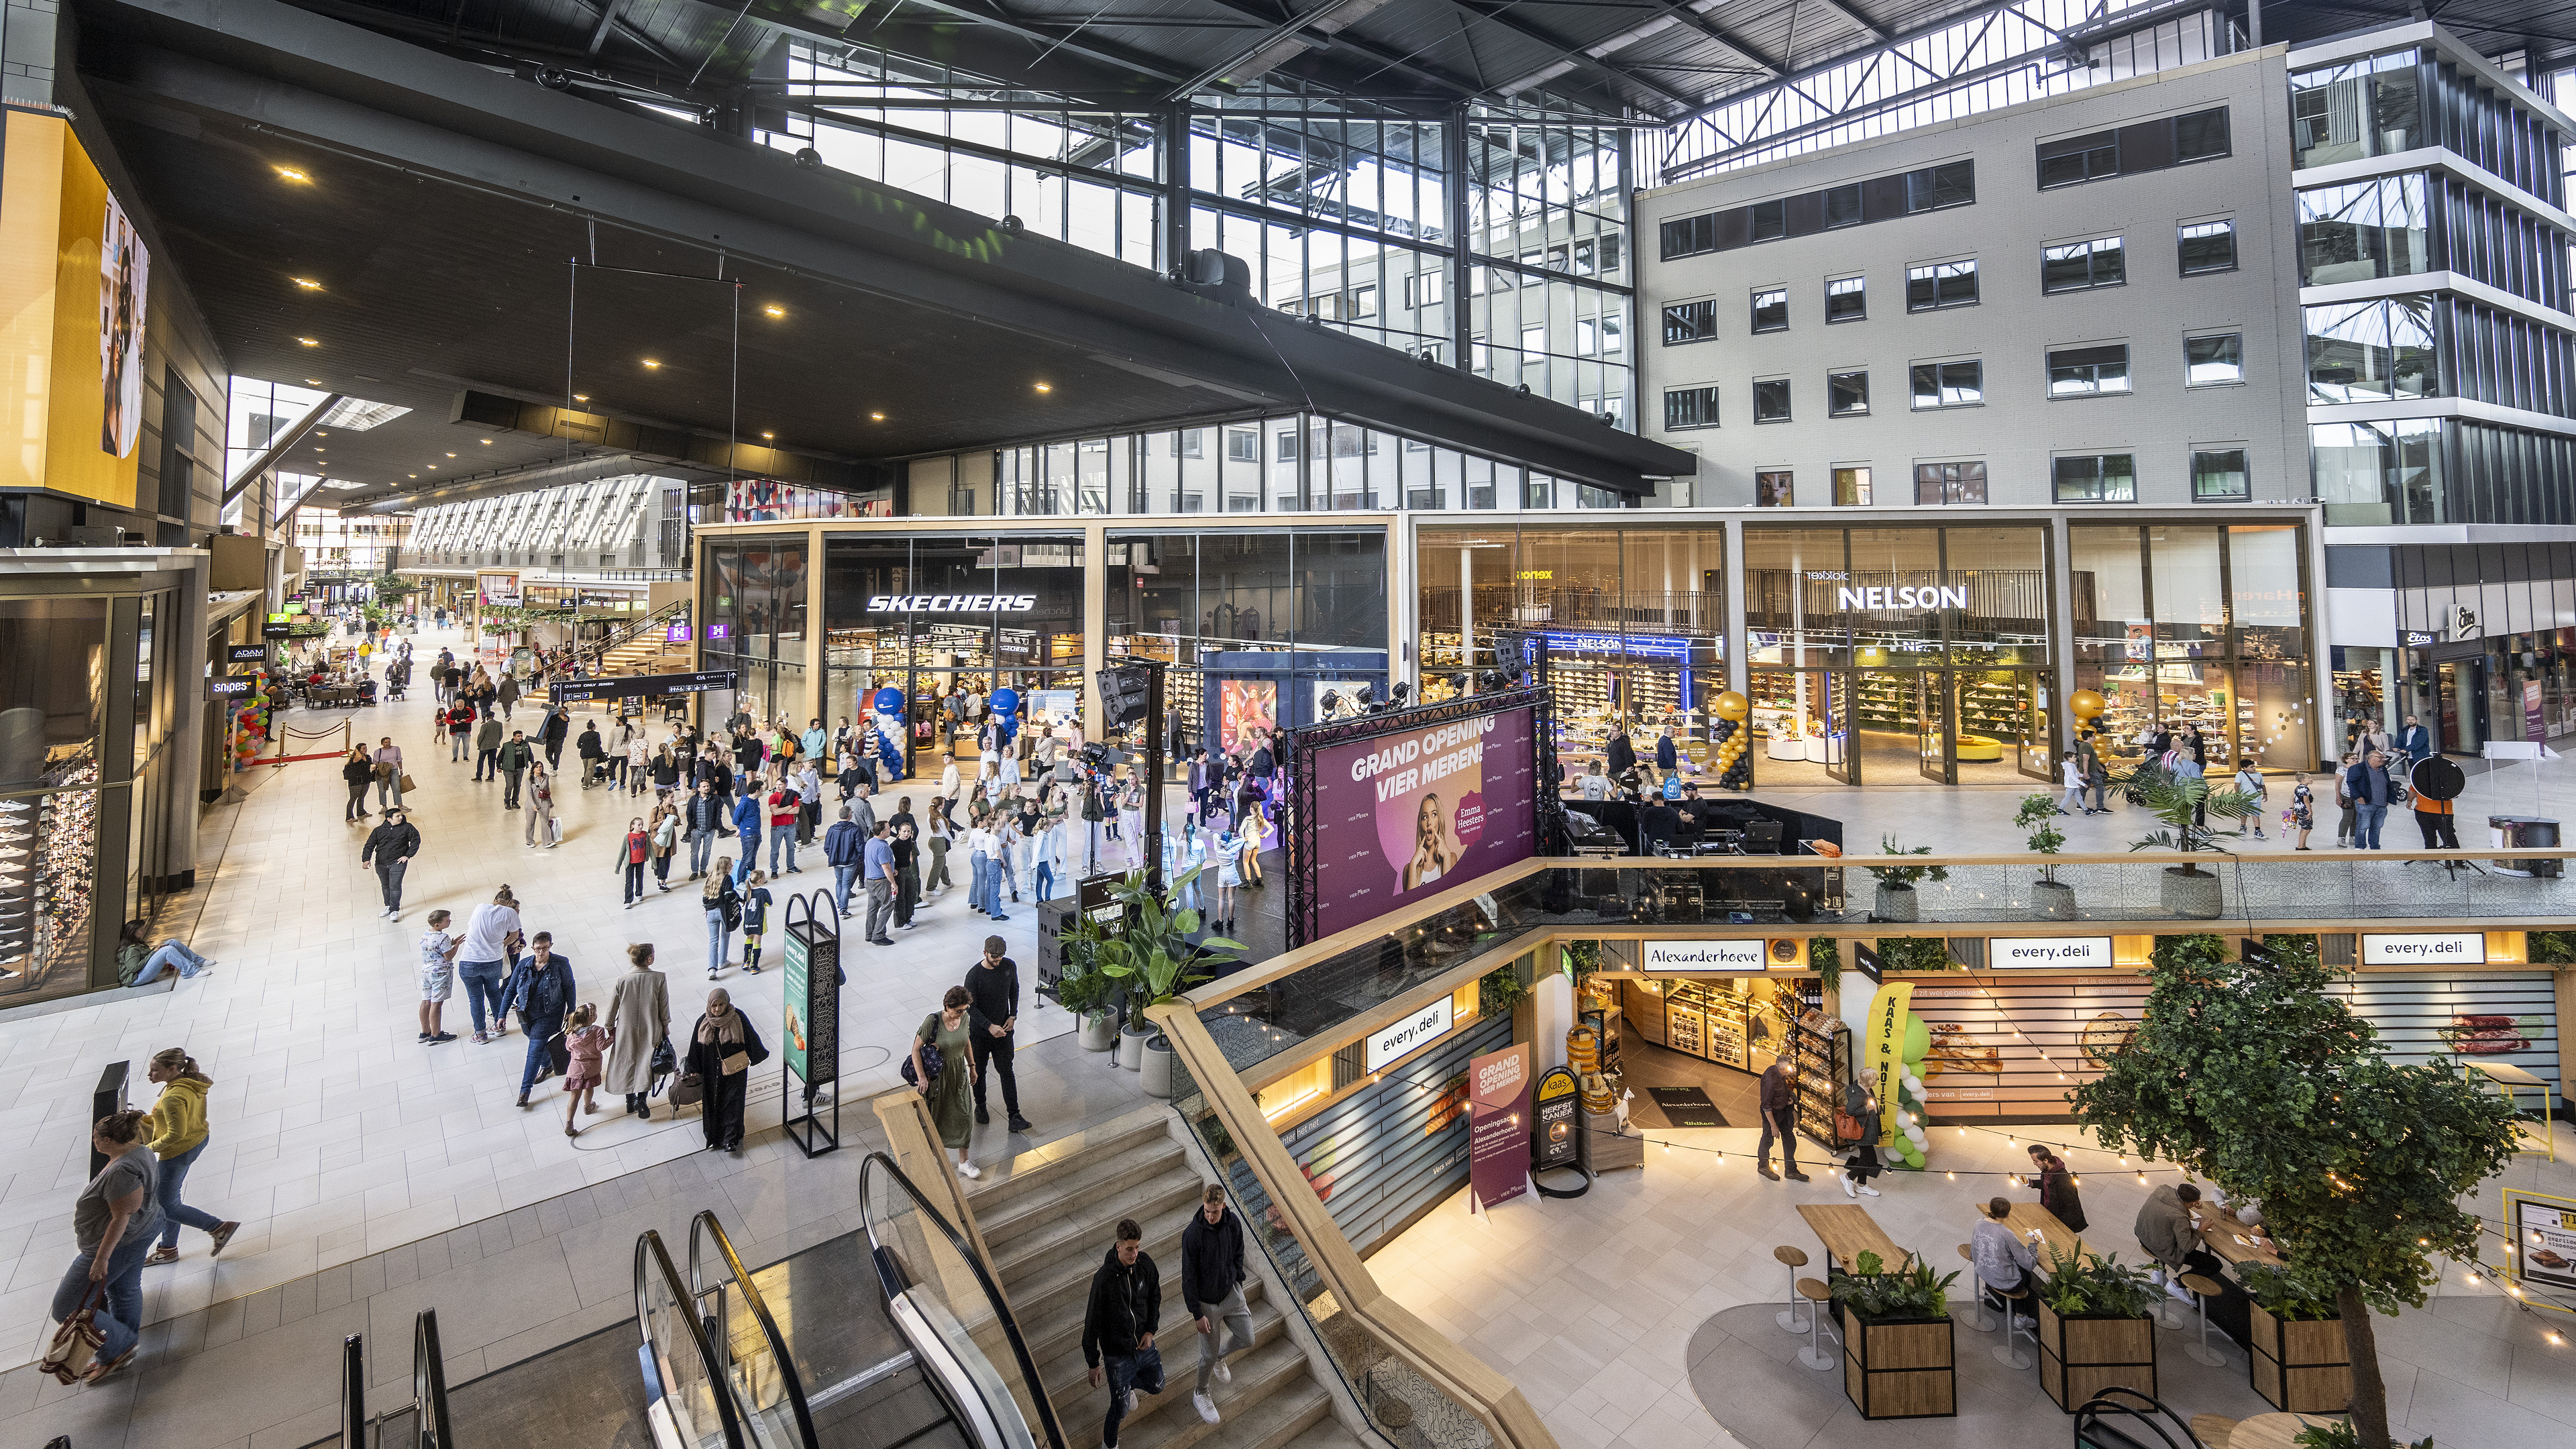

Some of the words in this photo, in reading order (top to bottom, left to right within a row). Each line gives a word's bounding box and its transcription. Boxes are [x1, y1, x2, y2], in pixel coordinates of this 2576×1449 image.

[489, 596, 523, 608] coffeecompany
[866, 594, 1037, 612] SKECHERS
[1839, 586, 1967, 610] NELSON
[1578, 638, 1622, 649] NELSON
[2408, 632, 2432, 643] Etos
[214, 682, 247, 693] snipes
[1226, 692, 1236, 727] UNO
[1351, 739, 1419, 782] GRAND
[1422, 714, 1495, 755] OPENING
[1377, 767, 1419, 803] VIER
[1421, 741, 1484, 786] MEREN!
[1458, 814, 1484, 828] Heesters
[1461, 806, 1481, 818] Emma
[747, 898, 757, 912] 4
[1651, 949, 1758, 963] Alexanderhoeve
[2499, 982, 2516, 991] kuip
[1884, 997, 1896, 1038] KAAS
[1429, 1046, 1446, 1061] neusje
[1446, 1040, 1456, 1051] van
[1456, 1036, 1463, 1044] de
[1464, 1029, 1475, 1040] zalm
[1881, 1043, 1891, 1055] &
[1479, 1055, 1519, 1079] GRAND
[1479, 1065, 1520, 1089] OPENING
[1480, 1084, 1495, 1096] VIER
[1496, 1072, 1521, 1089] MEREN!
[1548, 1079, 1566, 1091] kaas
[1878, 1061, 1889, 1116] NOTEN
[1542, 1101, 1573, 1115] HERFST
[1542, 1108, 1573, 1121] KANJER
[1282, 1133, 1295, 1144] hter
[1297, 1126, 1307, 1137] het
[1309, 1118, 1319, 1130] net
[1474, 1112, 1519, 1133] Openingsact!
[1474, 1125, 1517, 1144] Alexanderhoeve
[1433, 1165, 1444, 1175] Vers
[1446, 1157, 1454, 1167] van
[1511, 1184, 1526, 1193] MEREN
